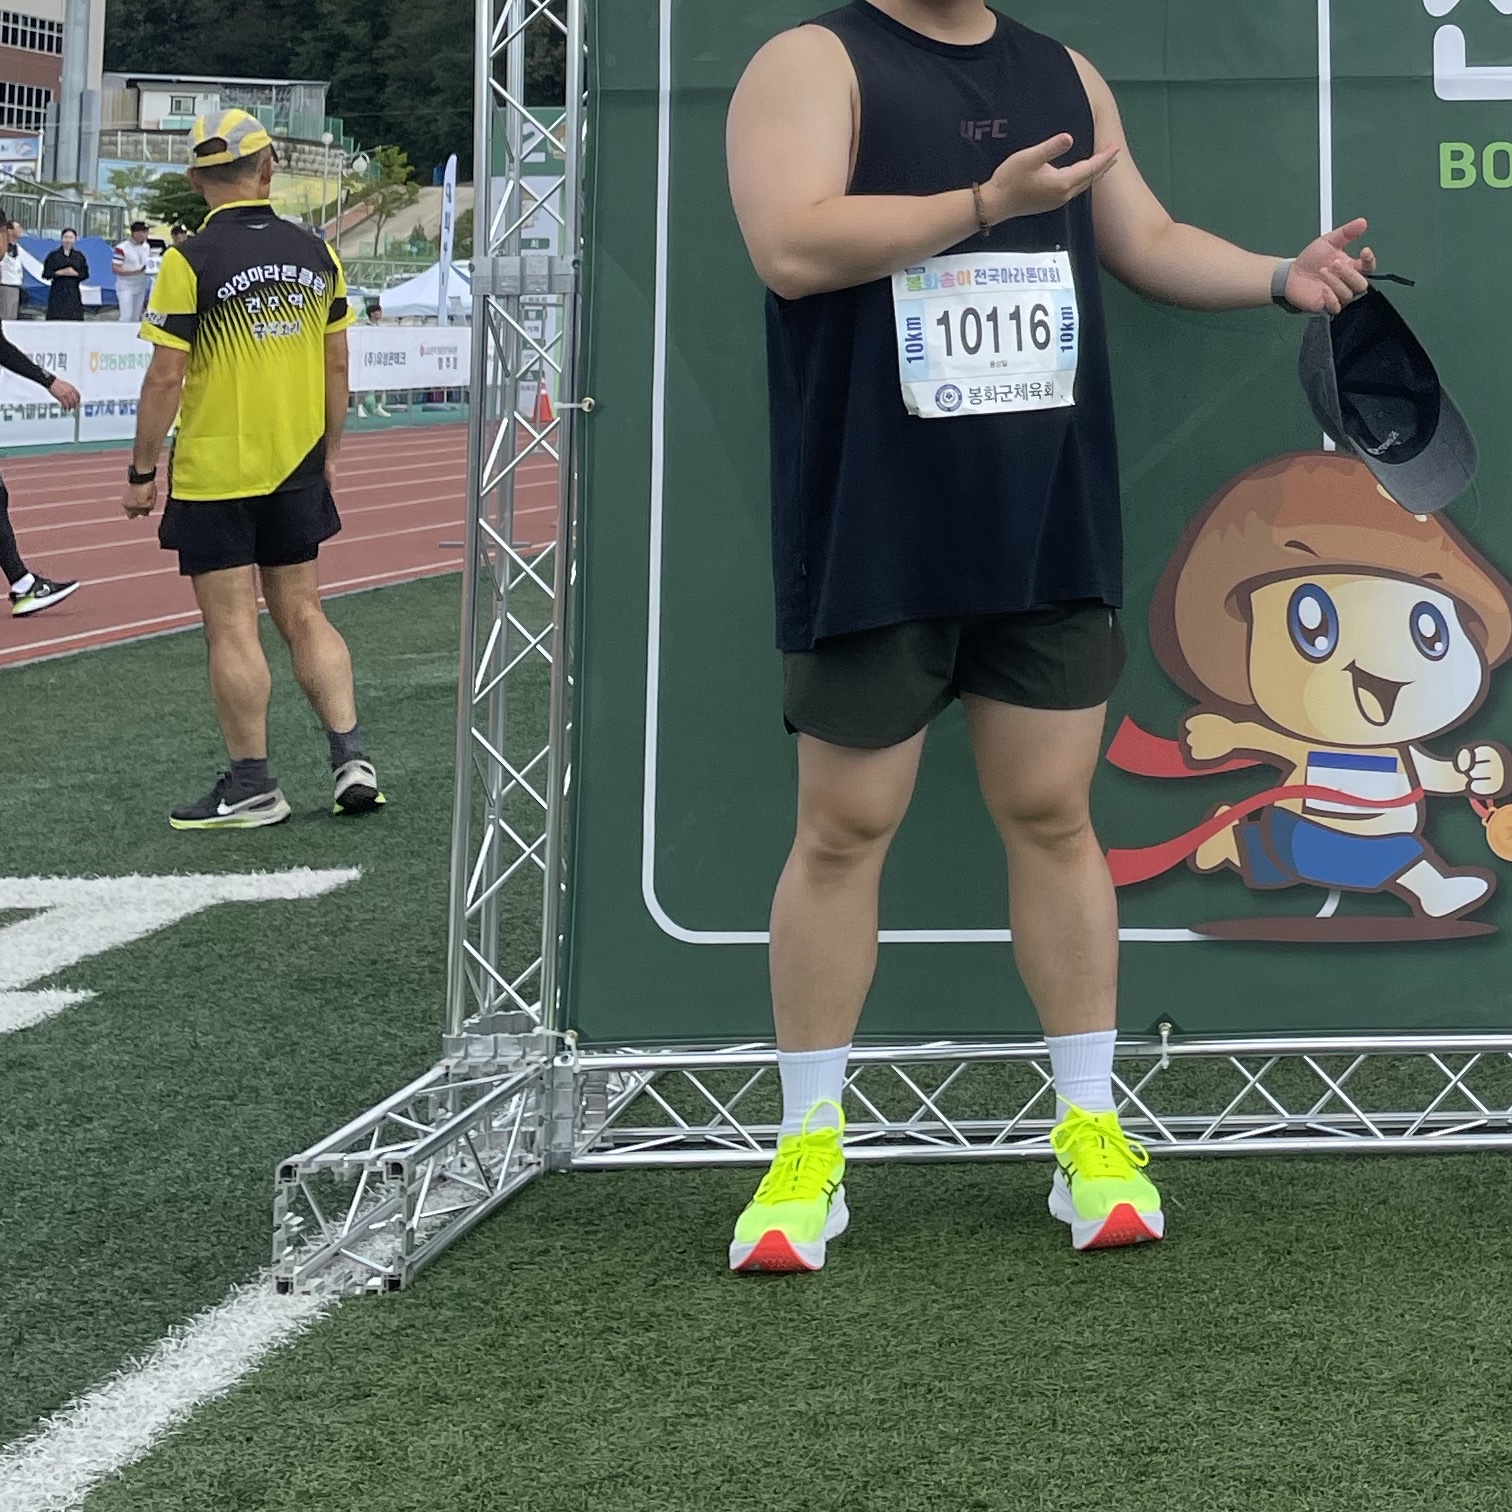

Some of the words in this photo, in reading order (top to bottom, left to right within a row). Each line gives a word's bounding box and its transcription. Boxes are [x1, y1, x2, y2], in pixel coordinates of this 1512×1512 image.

[960, 119, 1007, 141] UFC
[974, 267, 1062, 286] 전국마라톤대회
[905, 316, 925, 364] 10km
[937, 303, 1051, 357] 10116
[1060, 306, 1075, 353] 10km
[967, 380, 1056, 406] 봉화군체육회
